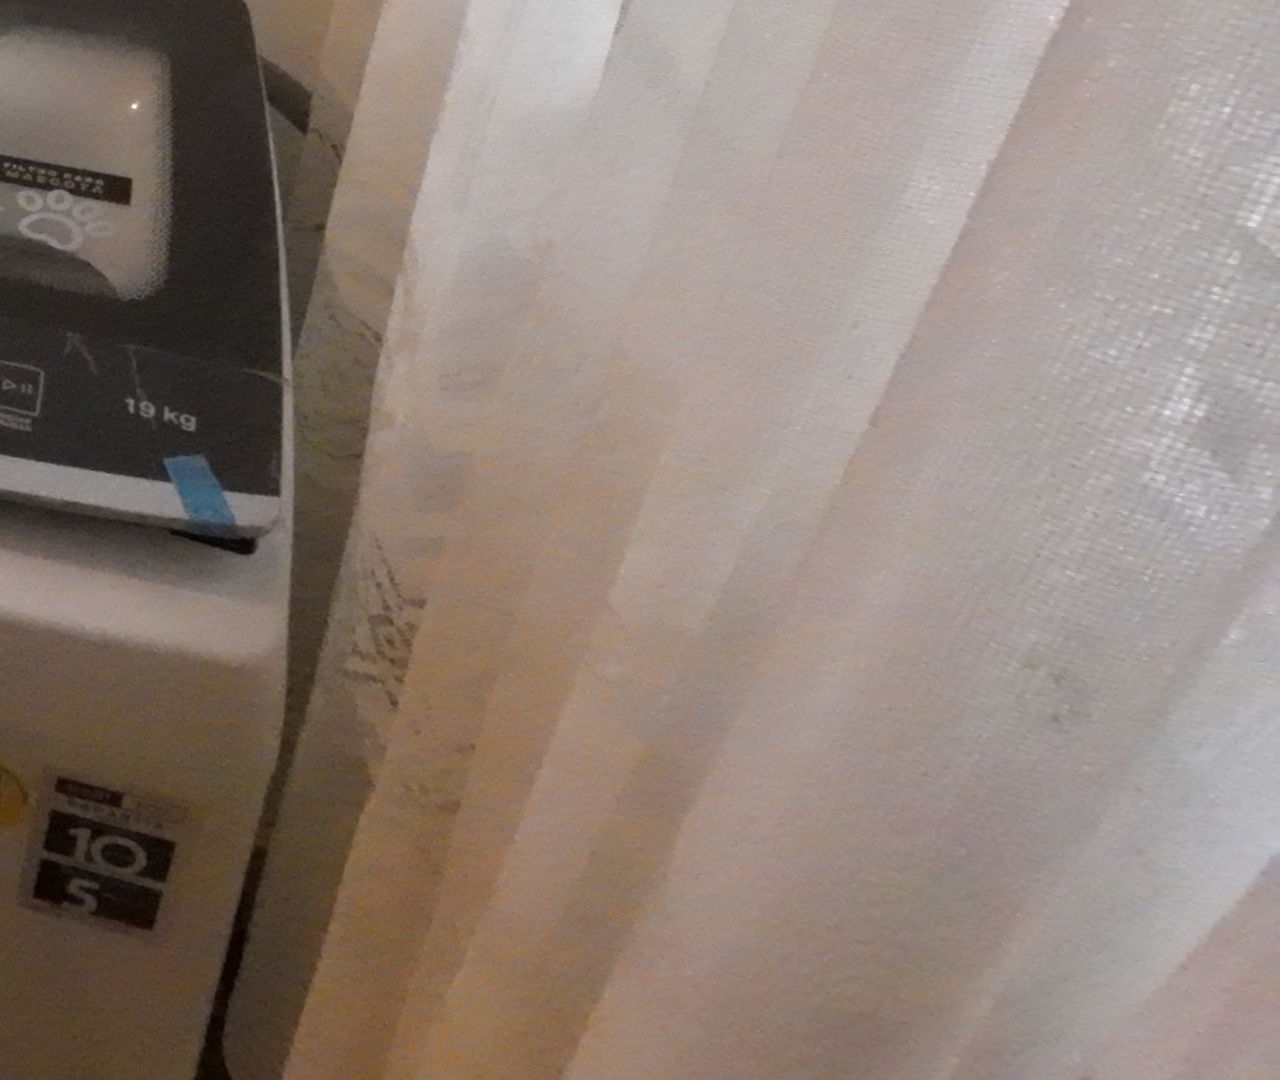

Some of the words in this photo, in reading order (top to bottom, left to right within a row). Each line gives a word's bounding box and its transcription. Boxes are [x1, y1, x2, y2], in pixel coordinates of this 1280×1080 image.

[124, 398, 156, 419] 19
[163, 405, 197, 432] kg
[67, 826, 148, 874] 10
